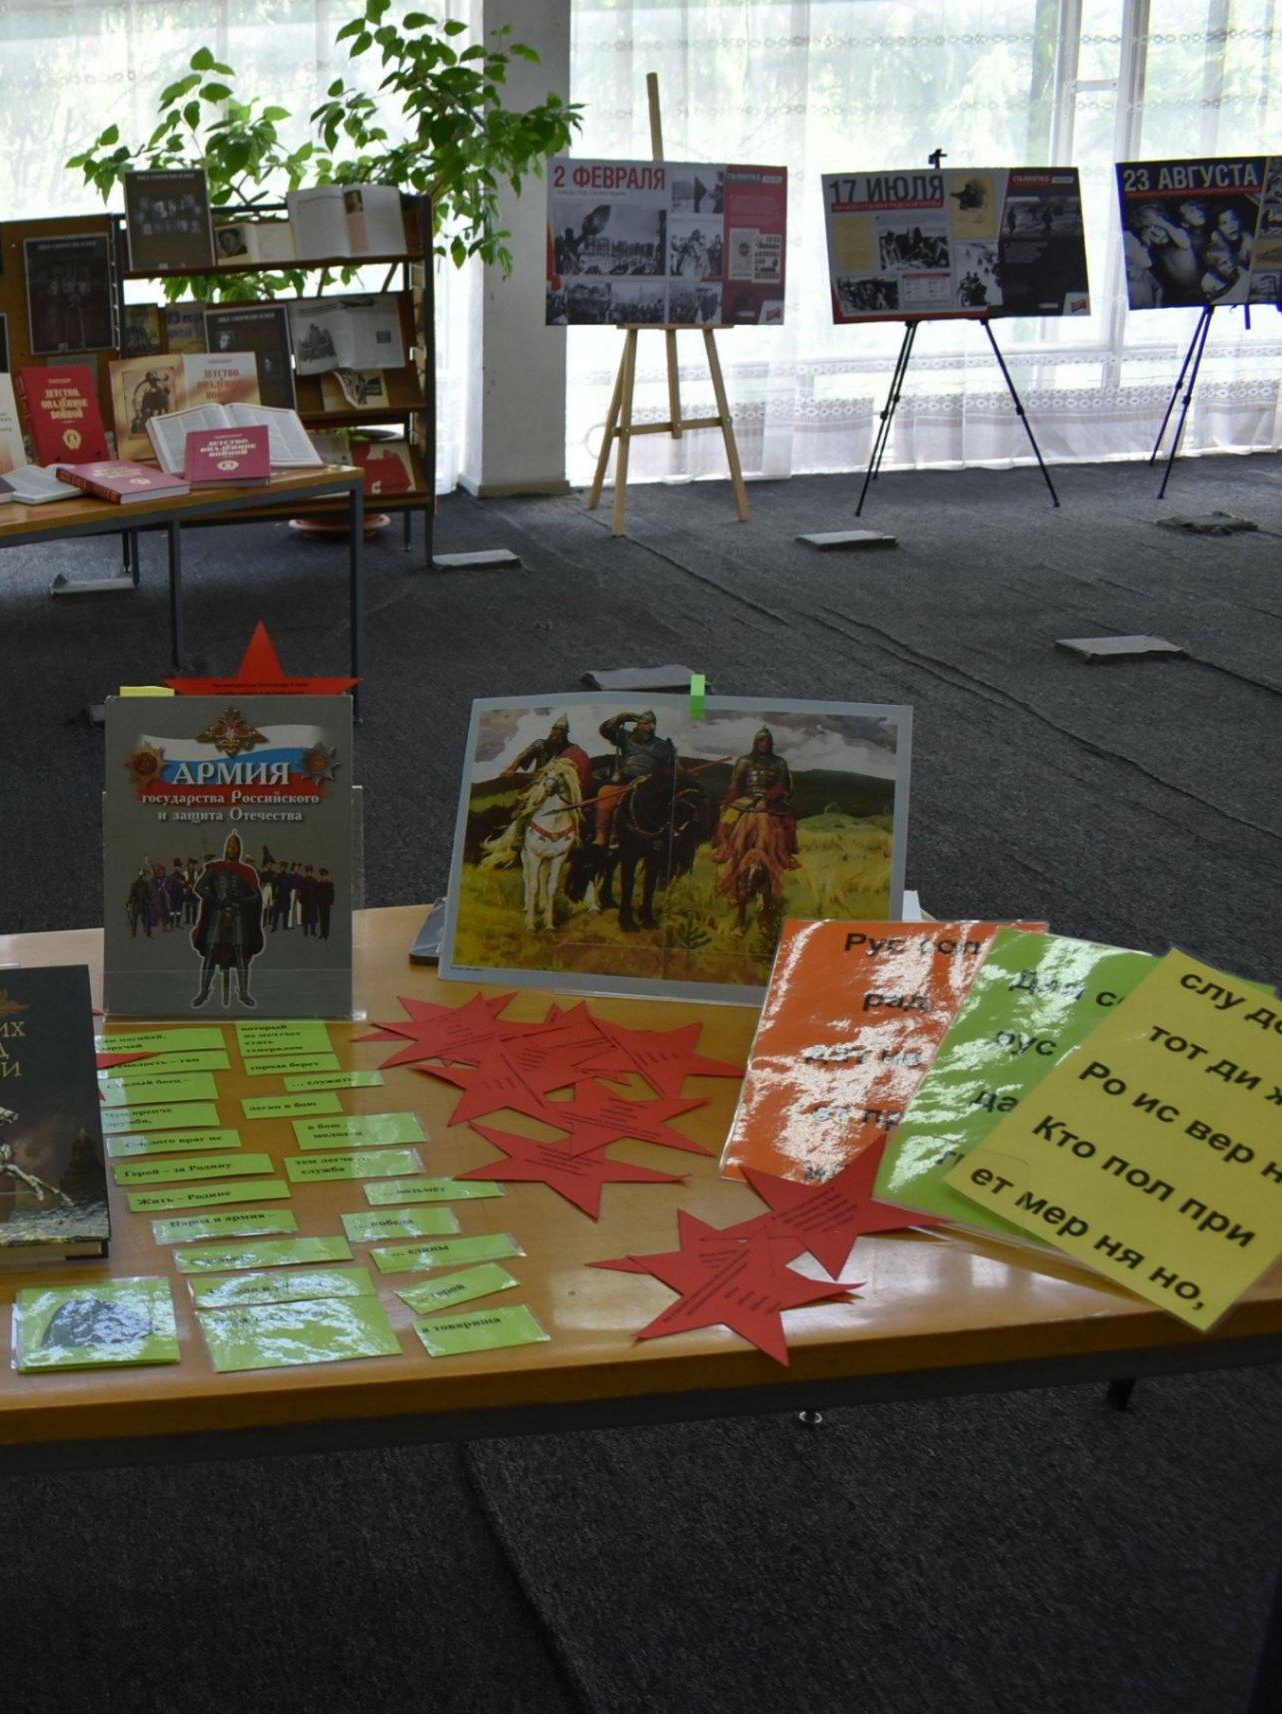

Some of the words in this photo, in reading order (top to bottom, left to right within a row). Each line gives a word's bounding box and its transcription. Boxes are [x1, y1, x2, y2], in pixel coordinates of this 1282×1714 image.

[554, 165, 565, 188] 2
[573, 166, 665, 190] ФЕВРАЛЯ
[830, 180, 856, 203] 17
[867, 175, 943, 201] ИЮЛЯ
[1123, 168, 1149, 191] 23
[1157, 163, 1258, 190] АВГУСТА
[172, 761, 290, 785] АРМИЯ
[142, 794, 225, 807] государства
[231, 790, 320, 805] Российского
[158, 811, 166, 820] и
[172, 811, 223, 823] защита
[229, 806, 303, 821] Отечества
[1180, 973, 1246, 1010] слу
[1150, 1025, 1209, 1060] тот
[1204, 1059, 1263, 1091] ди
[1078, 1060, 1127, 1096] Ро
[1132, 1092, 1180, 1123] ис
[1185, 1119, 1255, 1165] вер
[125, 1169, 159, 1178] Герой
[189, 1163, 232, 1171] Родину
[1032, 1115, 1097, 1159] Кто
[1101, 1155, 1176, 1203] пол
[1179, 1197, 1257, 1248] при
[137, 1197, 174, 1206] Жить
[188, 1191, 231, 1200] Родине
[170, 1218, 210, 1228] Народ
[225, 1213, 265, 1222] армия
[407, 1244, 449, 1253] едины
[970, 1166, 1014, 1196] ет
[1015, 1191, 1090, 1238] мер
[1093, 1234, 1145, 1270] ня
[1149, 1266, 1206, 1311] но,
[434, 1316, 501, 1331] товарища
